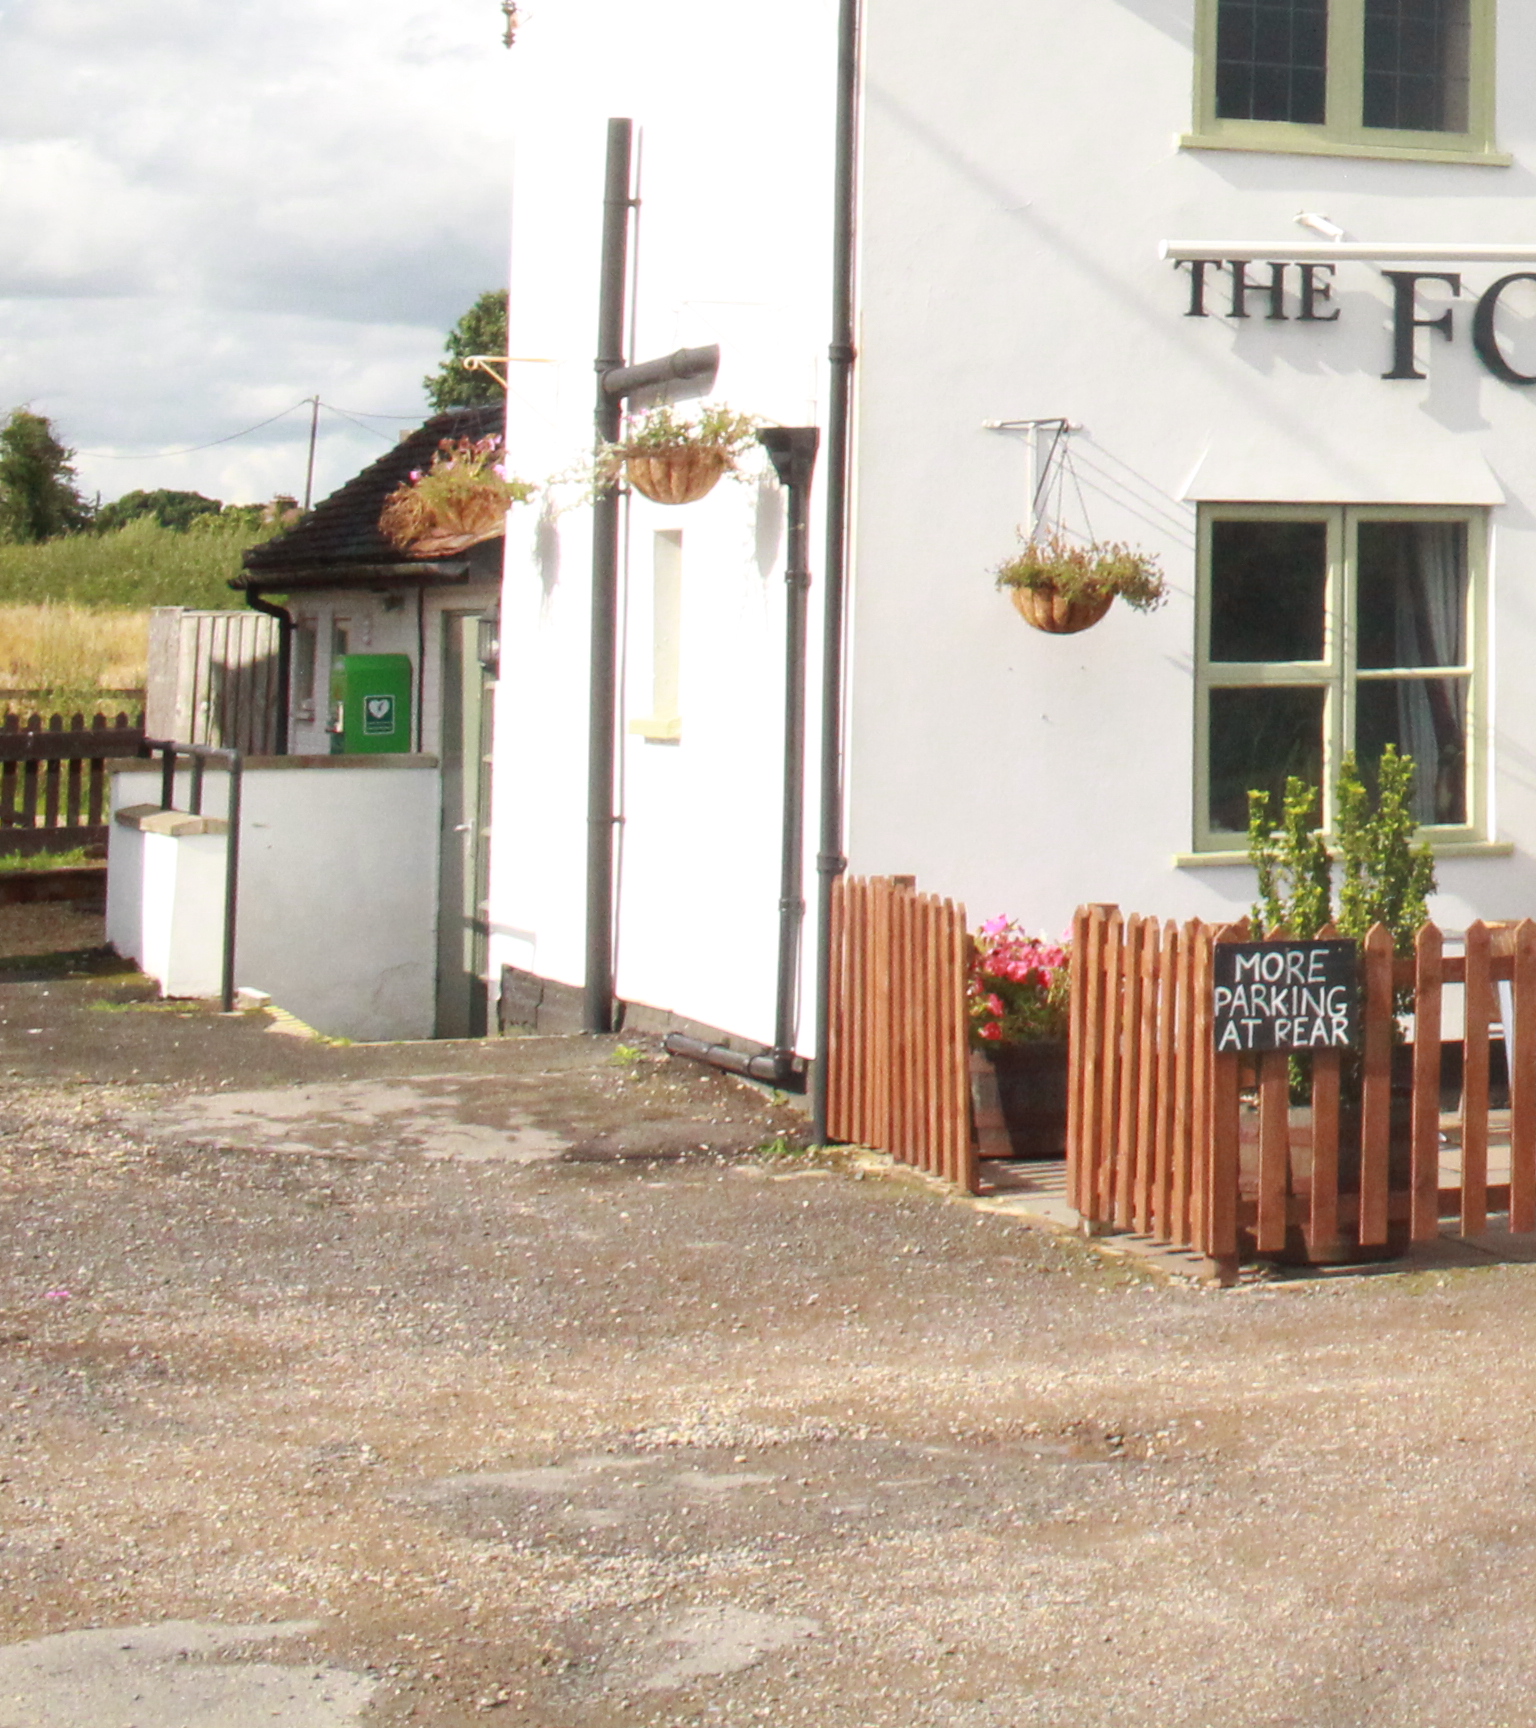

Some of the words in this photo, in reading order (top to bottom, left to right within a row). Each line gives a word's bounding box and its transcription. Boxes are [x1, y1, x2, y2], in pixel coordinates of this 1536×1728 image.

[1174, 259, 1341, 321] THE
[1234, 949, 1330, 984] MORE
[1214, 983, 1347, 1017] PARKING
[1218, 1018, 1262, 1051] AT
[1274, 1017, 1349, 1047] REAR
